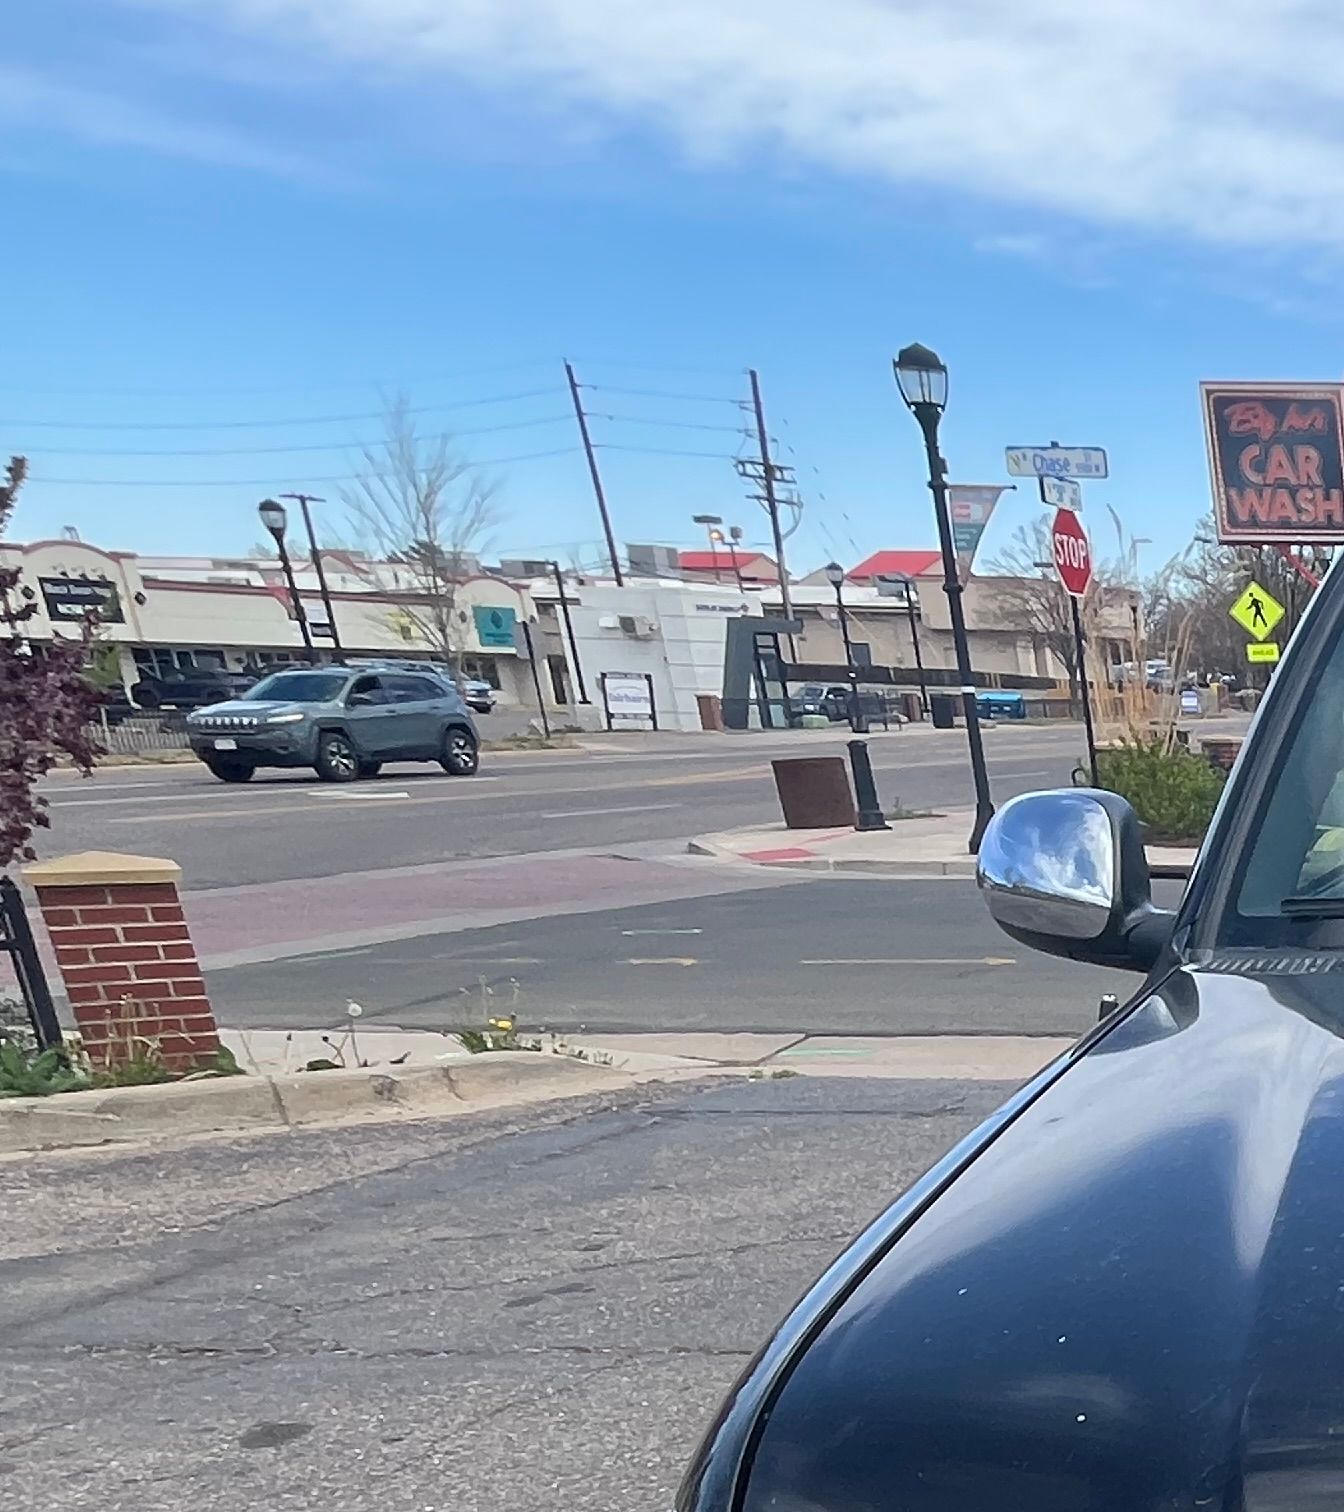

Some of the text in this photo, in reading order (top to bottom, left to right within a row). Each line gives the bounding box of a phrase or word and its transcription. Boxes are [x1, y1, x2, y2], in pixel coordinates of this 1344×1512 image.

[1033, 453, 1070, 473] Chase
[1239, 444, 1322, 486] CAR
[1227, 486, 1344, 525] WASH
[1054, 532, 1087, 570] STOP
